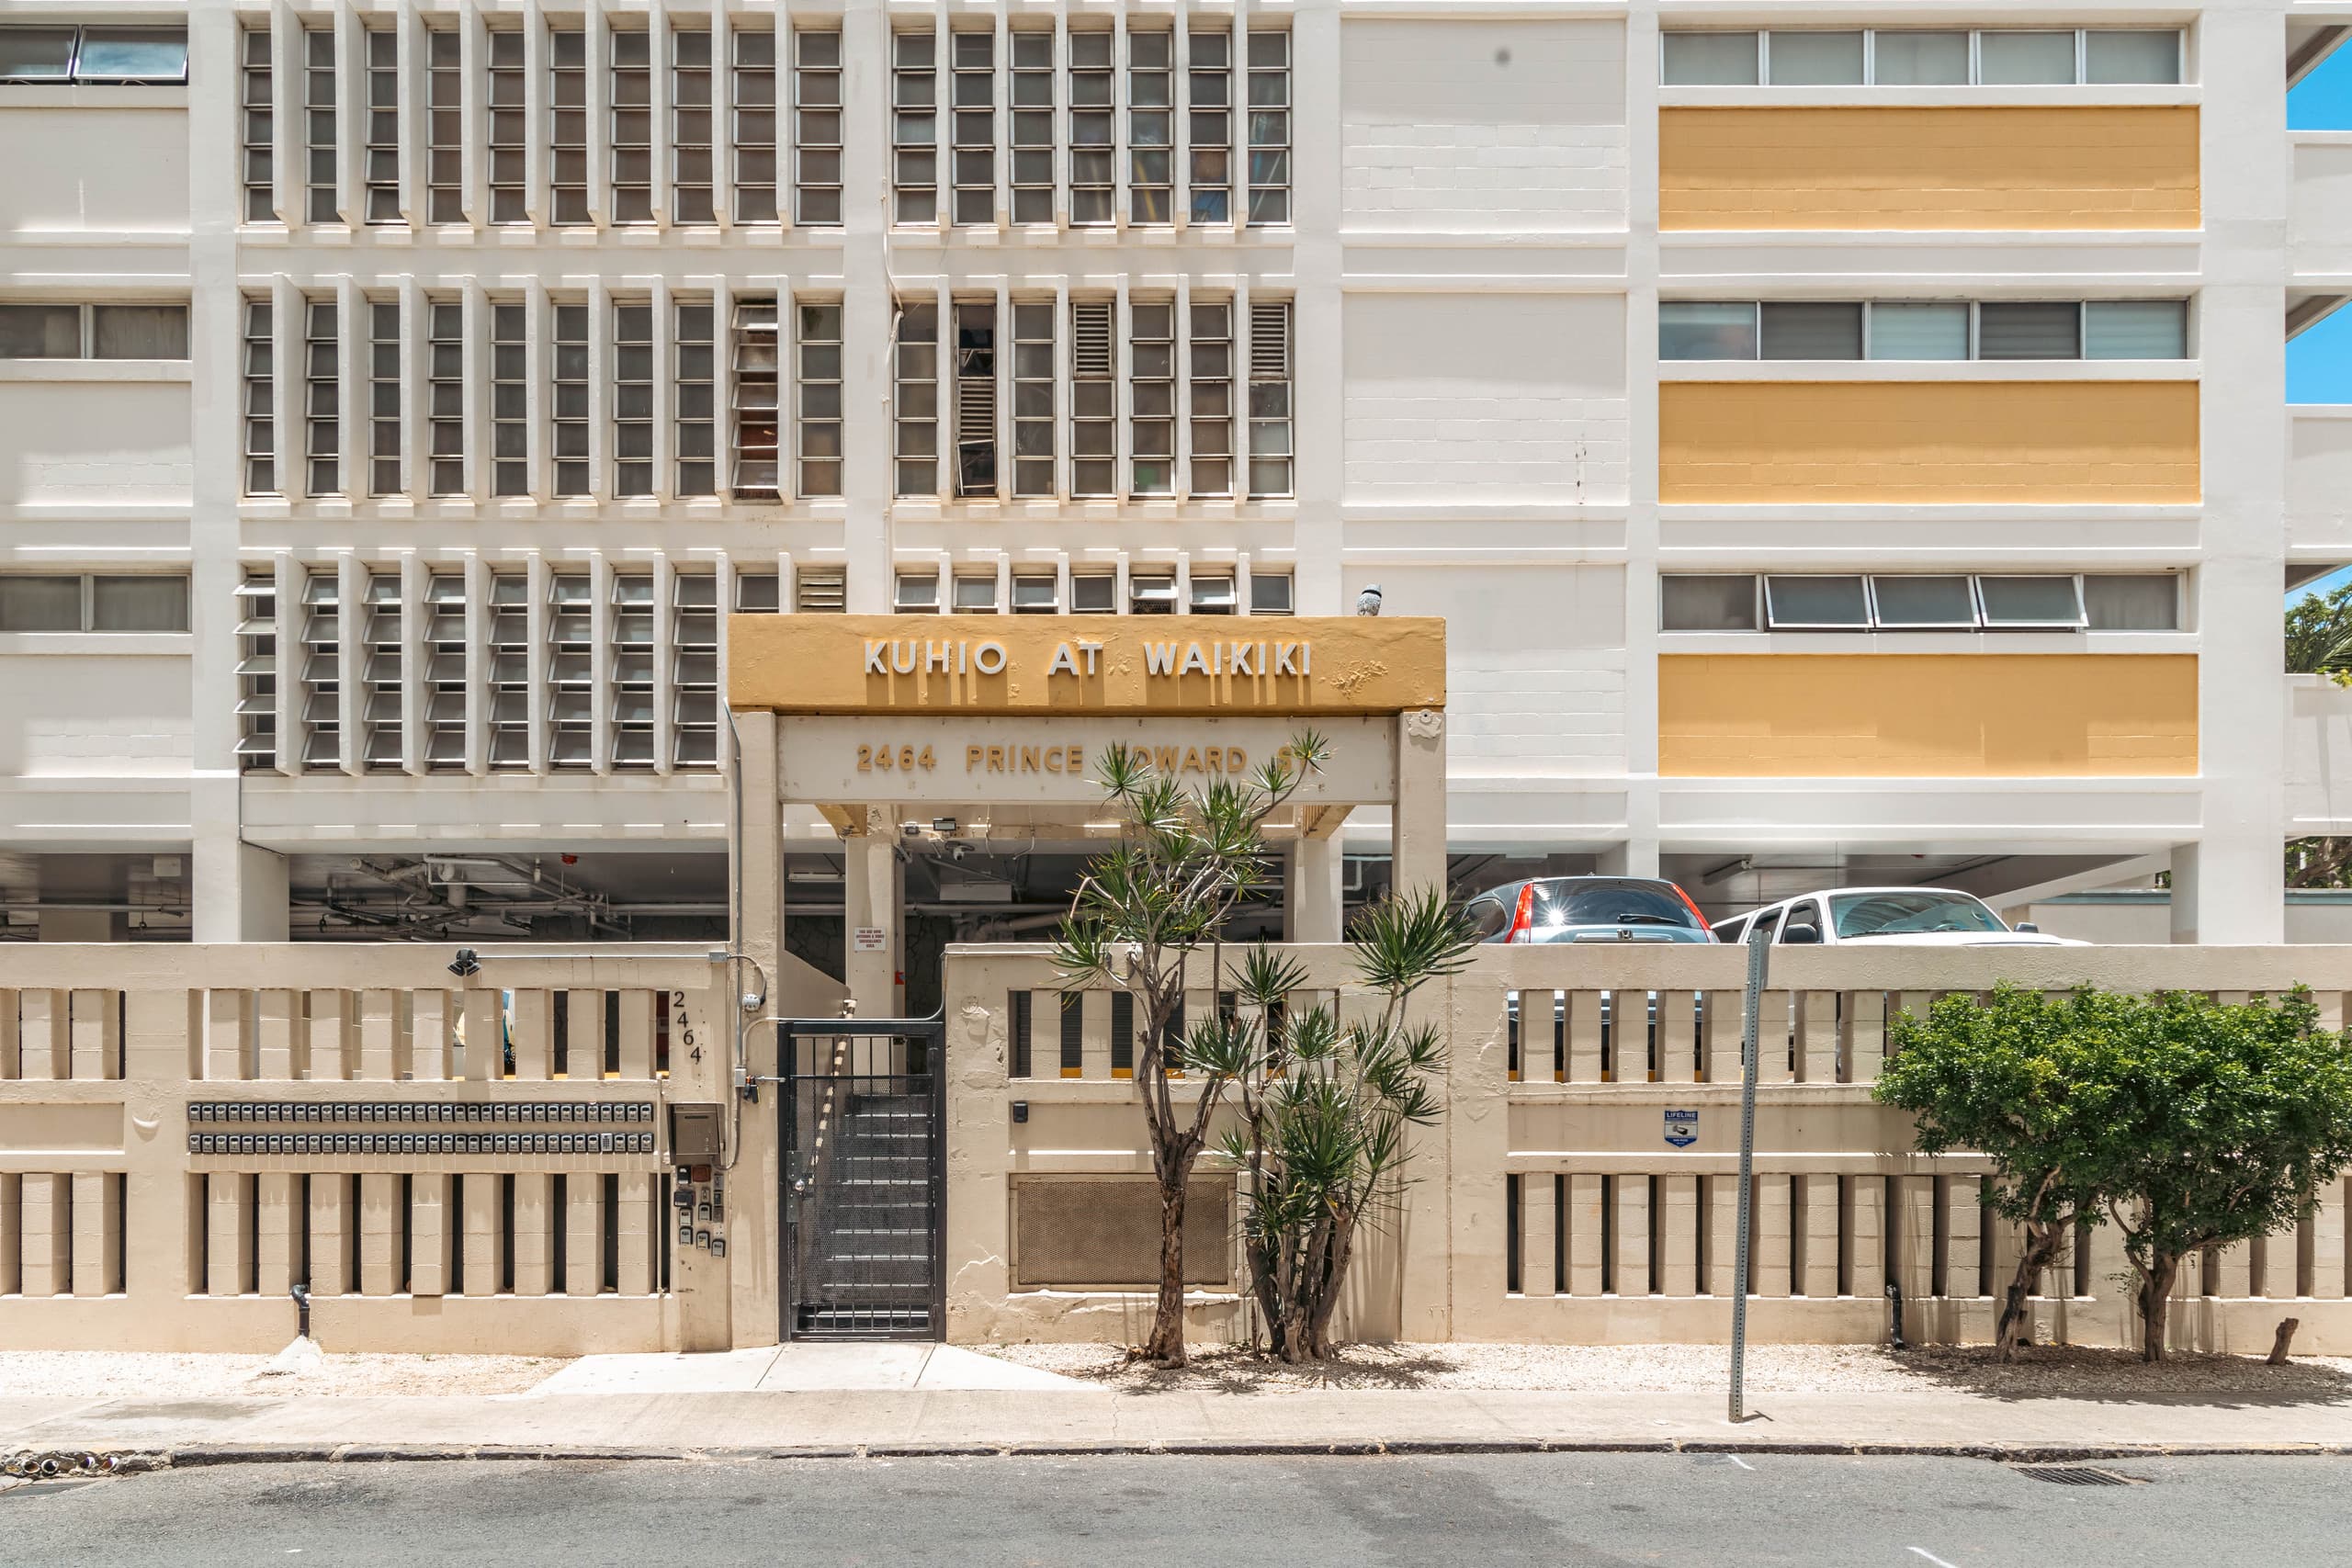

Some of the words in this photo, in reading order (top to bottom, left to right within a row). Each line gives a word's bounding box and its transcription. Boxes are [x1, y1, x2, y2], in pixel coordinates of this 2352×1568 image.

[865, 640, 1007, 675] KUHIO
[1047, 642, 1102, 676] AT
[1144, 641, 1310, 676] WAIKIKI
[857, 744, 937, 772] 2464
[967, 745, 1082, 773] PRINCE
[673, 991, 702, 1063] 2464
